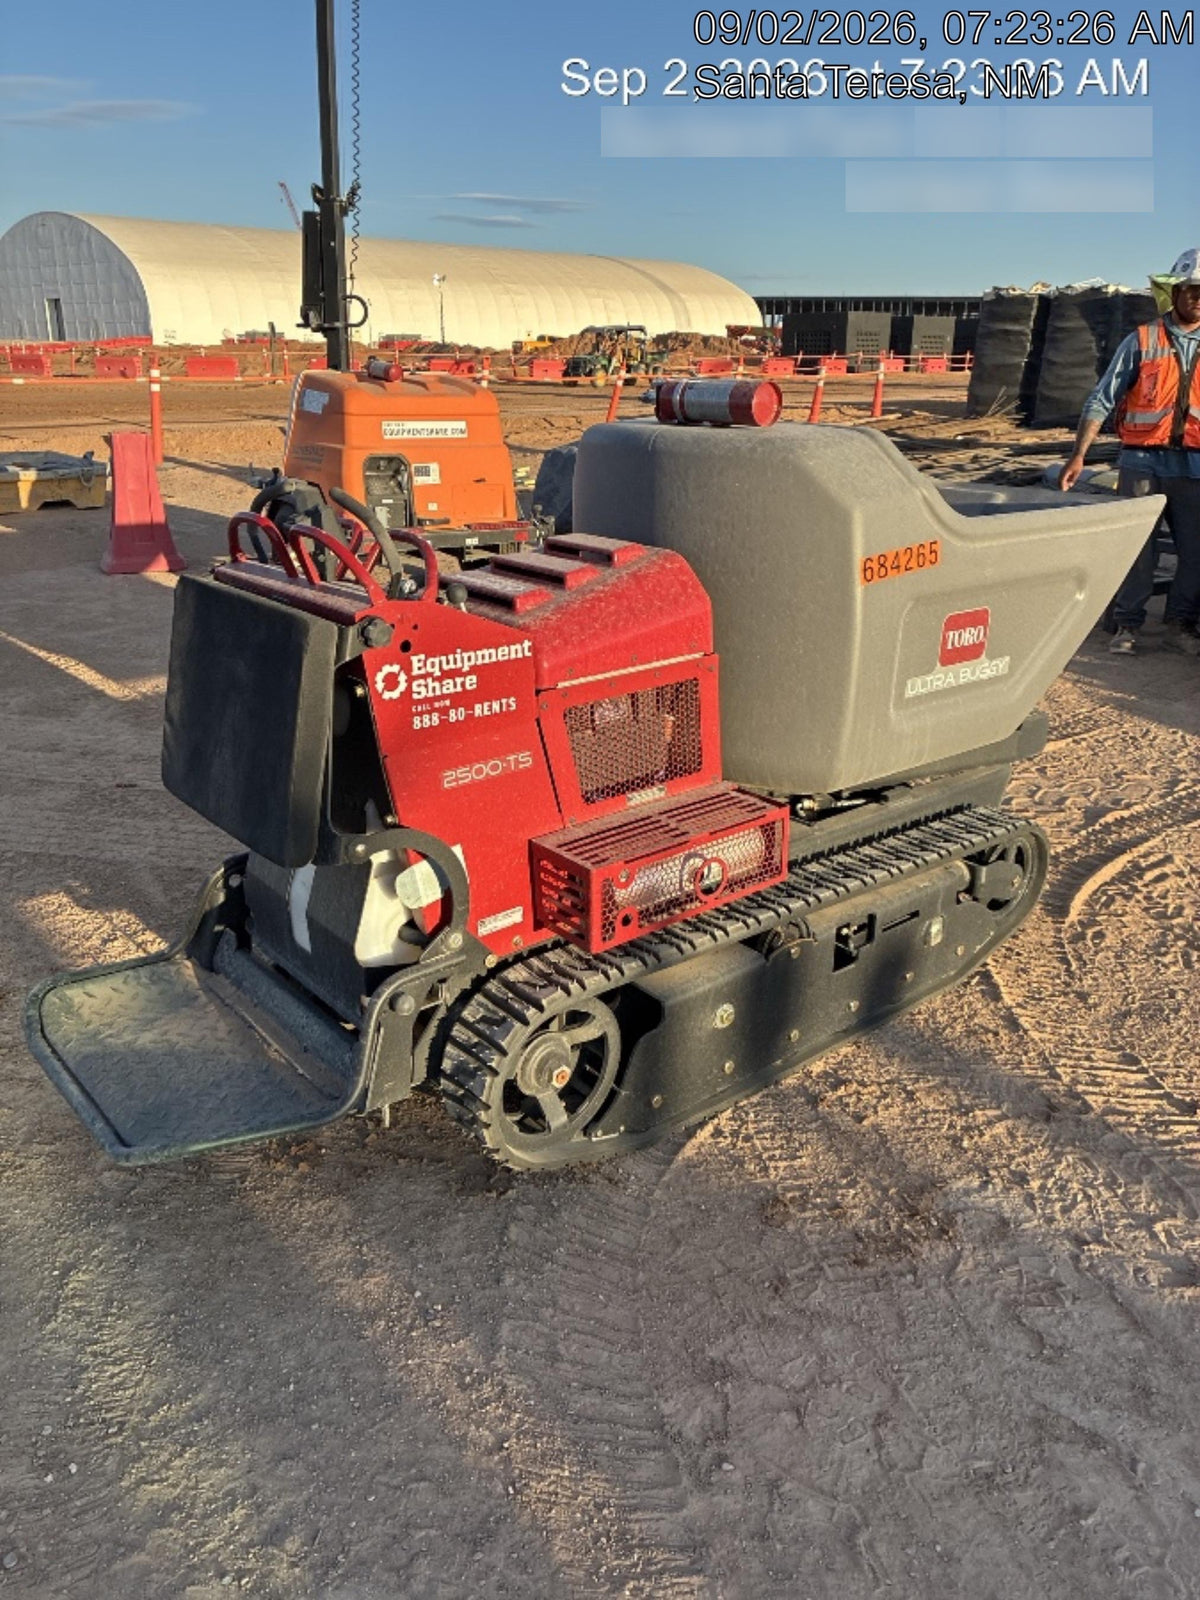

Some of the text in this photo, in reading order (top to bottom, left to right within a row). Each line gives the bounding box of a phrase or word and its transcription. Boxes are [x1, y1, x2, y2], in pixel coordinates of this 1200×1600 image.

[863, 540, 939, 583] 684265
[946, 625, 985, 650] TORO
[410, 639, 533, 677] Equipment
[411, 674, 478, 700] Share
[906, 656, 1010, 696] ULTRA BUGGY
[412, 697, 517, 730] 888-80-RENTS
